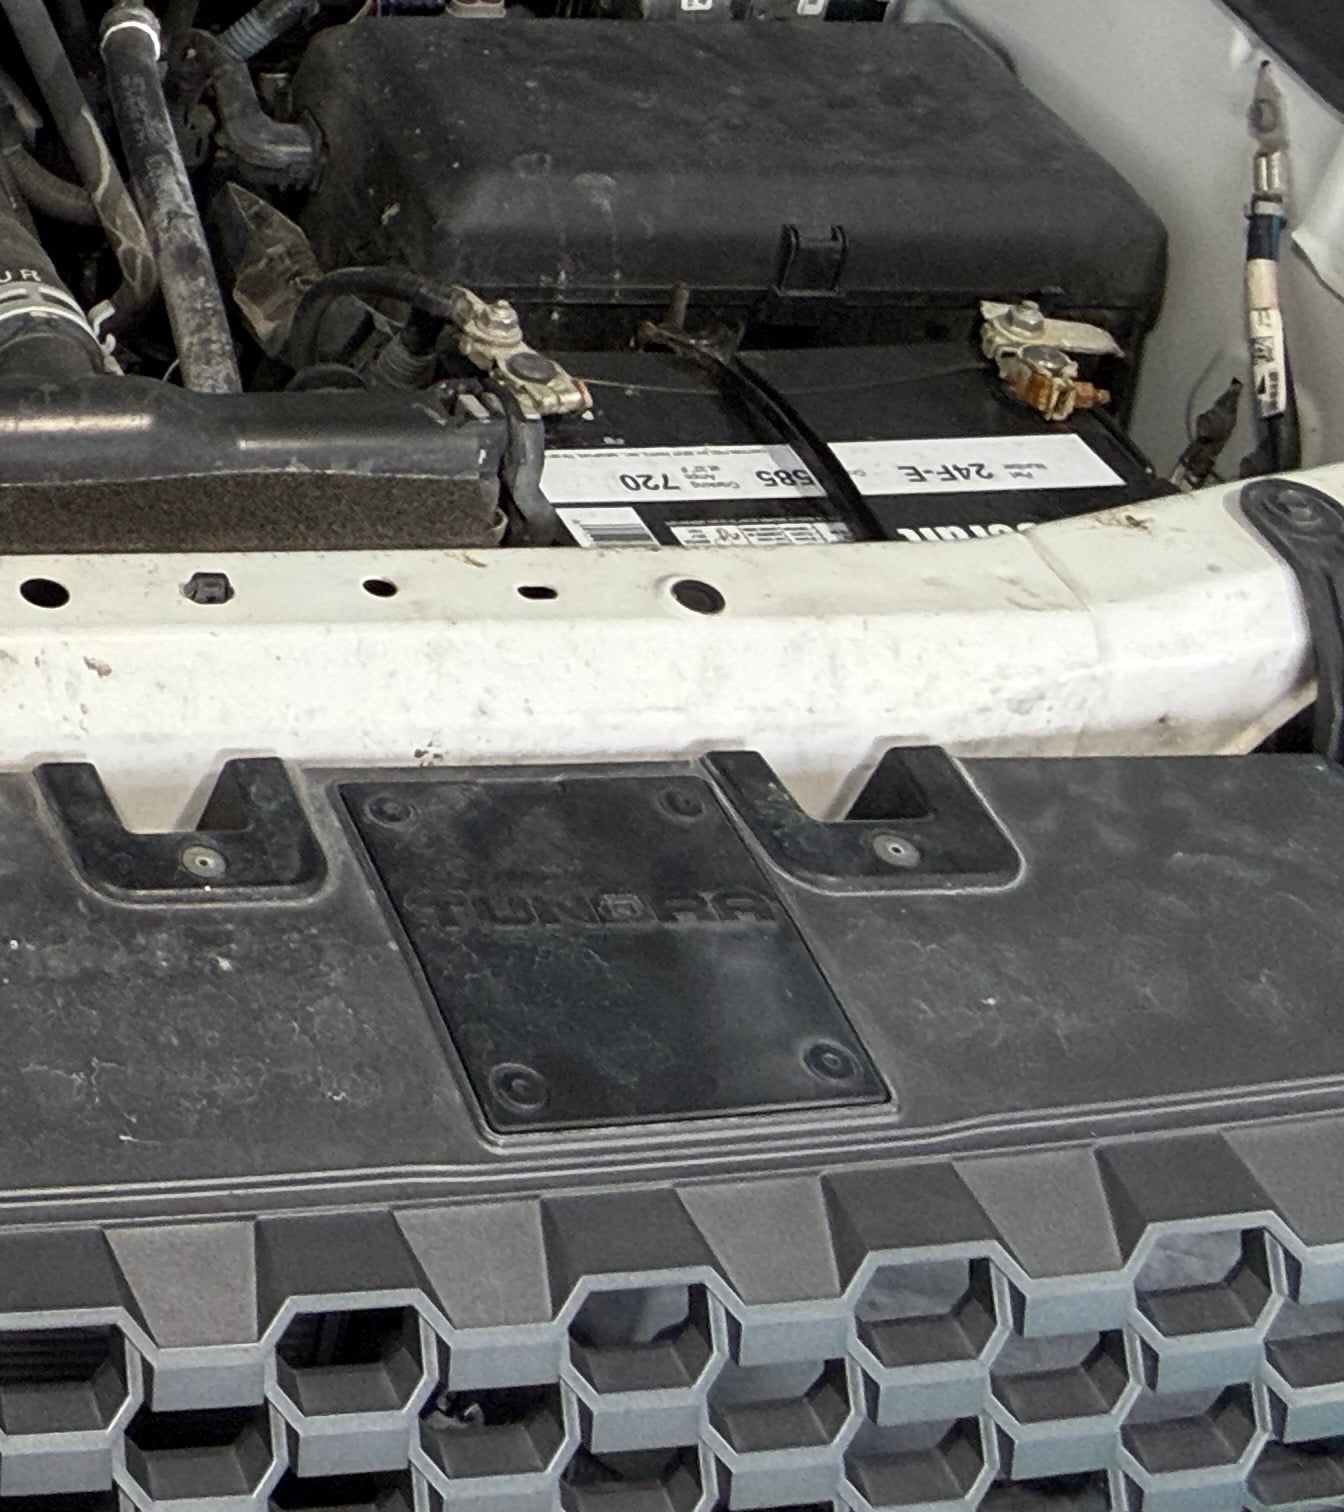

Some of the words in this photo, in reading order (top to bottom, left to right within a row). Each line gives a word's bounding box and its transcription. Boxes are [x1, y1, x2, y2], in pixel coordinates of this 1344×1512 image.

[619, 473, 681, 492] 720
[756, 469, 814, 487] 585
[897, 462, 994, 483] 24F-E
[404, 889, 780, 930] TUNDRA
